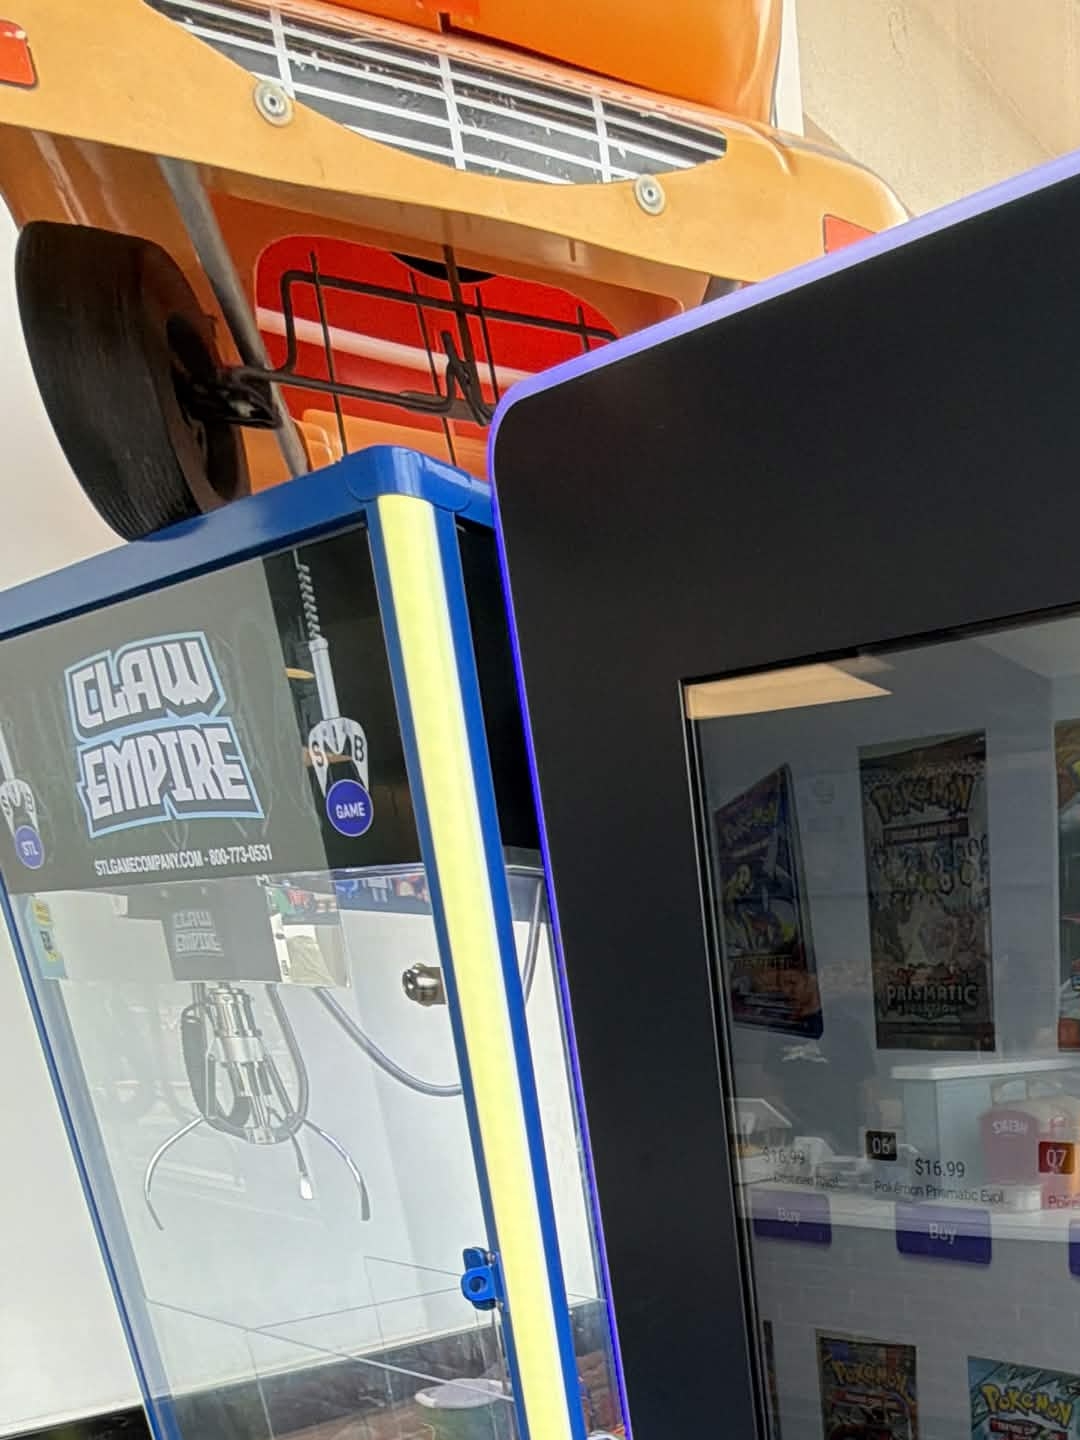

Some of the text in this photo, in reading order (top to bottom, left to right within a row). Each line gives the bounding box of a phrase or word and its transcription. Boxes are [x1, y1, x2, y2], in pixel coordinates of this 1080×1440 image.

[71, 640, 214, 729] CLAW
[82, 727, 252, 820] EMPIRE
[336, 802, 367, 820] GAME
[21, 840, 39, 857] STL
[94, 850, 204, 876] STLGAMECOMPANY.COM
[209, 844, 273, 866] 800-773-0531
[888, 984, 978, 1007] PRISMATIC
[914, 1158, 966, 1178] $16.99
[1046, 1149, 1068, 1168] 07
[928, 1223, 960, 1245] Buy
